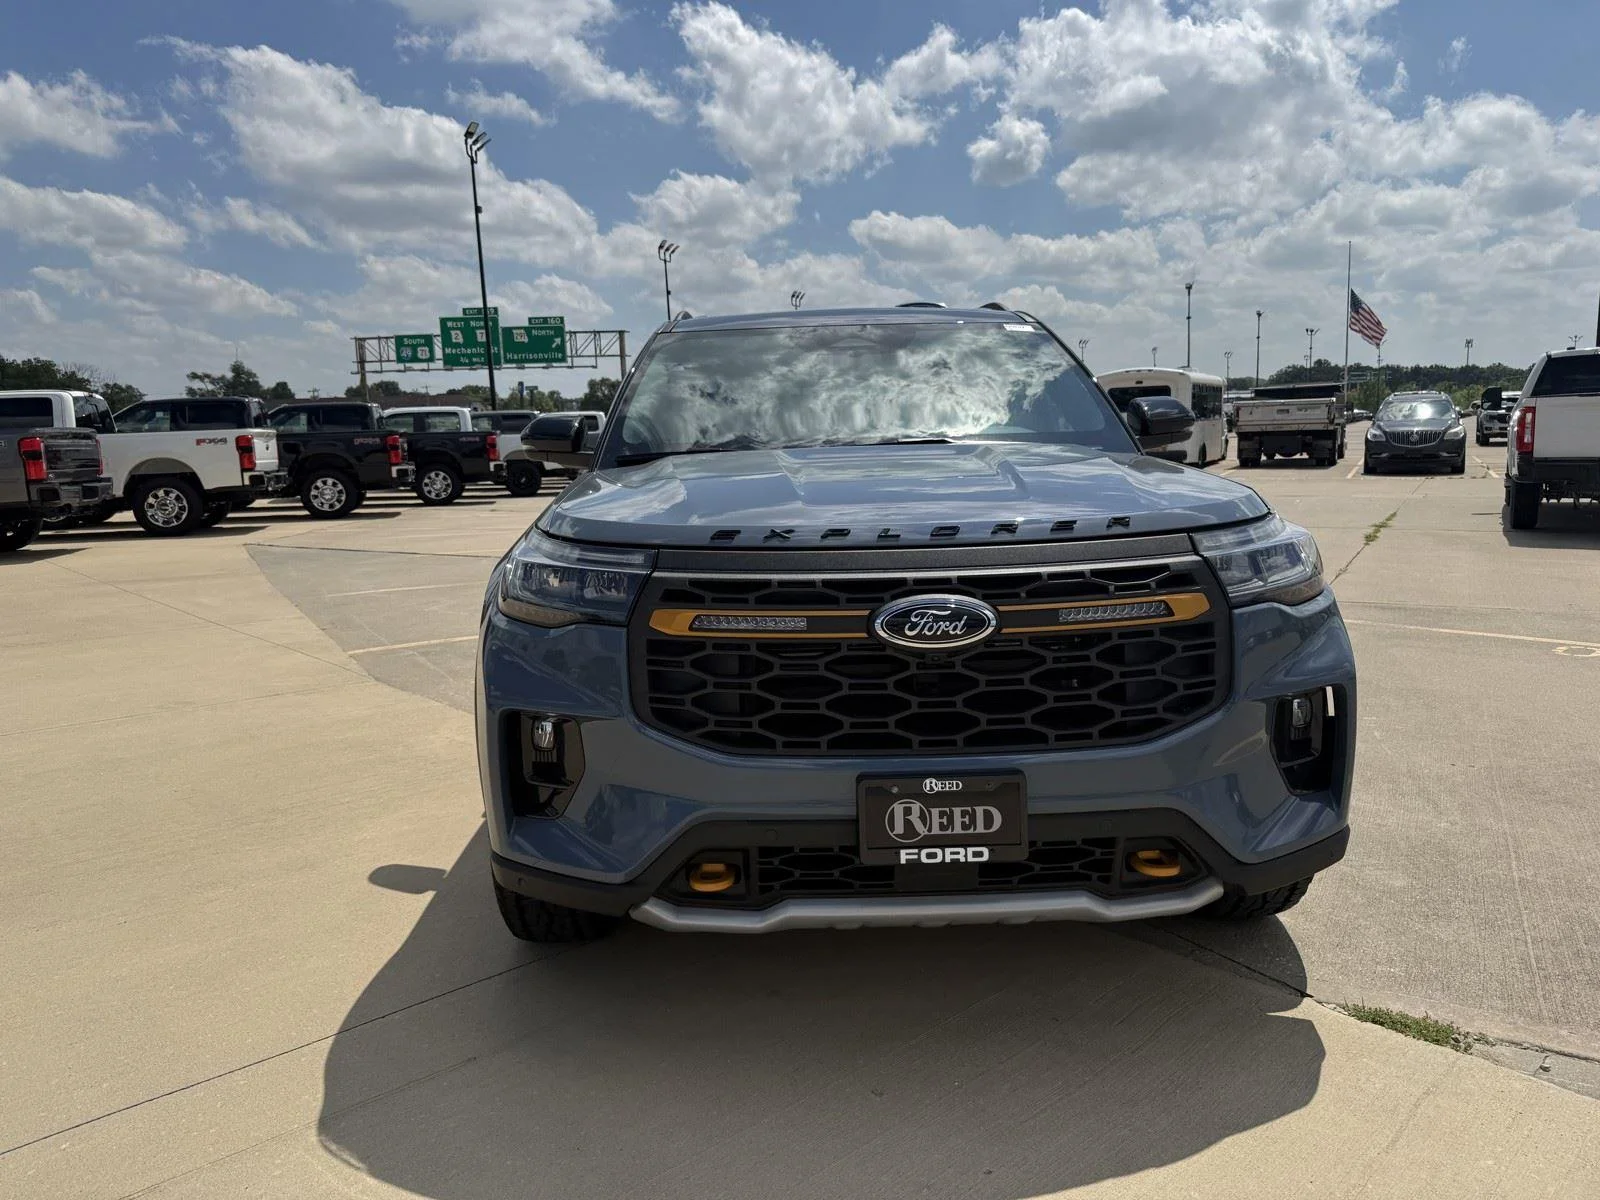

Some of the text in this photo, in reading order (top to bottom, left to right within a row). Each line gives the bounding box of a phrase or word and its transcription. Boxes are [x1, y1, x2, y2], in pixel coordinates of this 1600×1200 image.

[531, 329, 555, 337] NORTH
[403, 337, 425, 345] SOUTH
[418, 349, 428, 357] 71
[445, 347, 485, 355] Mechanic
[506, 351, 563, 361] Harrisonville
[709, 516, 1131, 542] EXPLORER
[904, 609, 967, 637] Ford
[923, 778, 962, 794] REED
[887, 800, 1002, 840] REED
[900, 847, 989, 864] FORD
